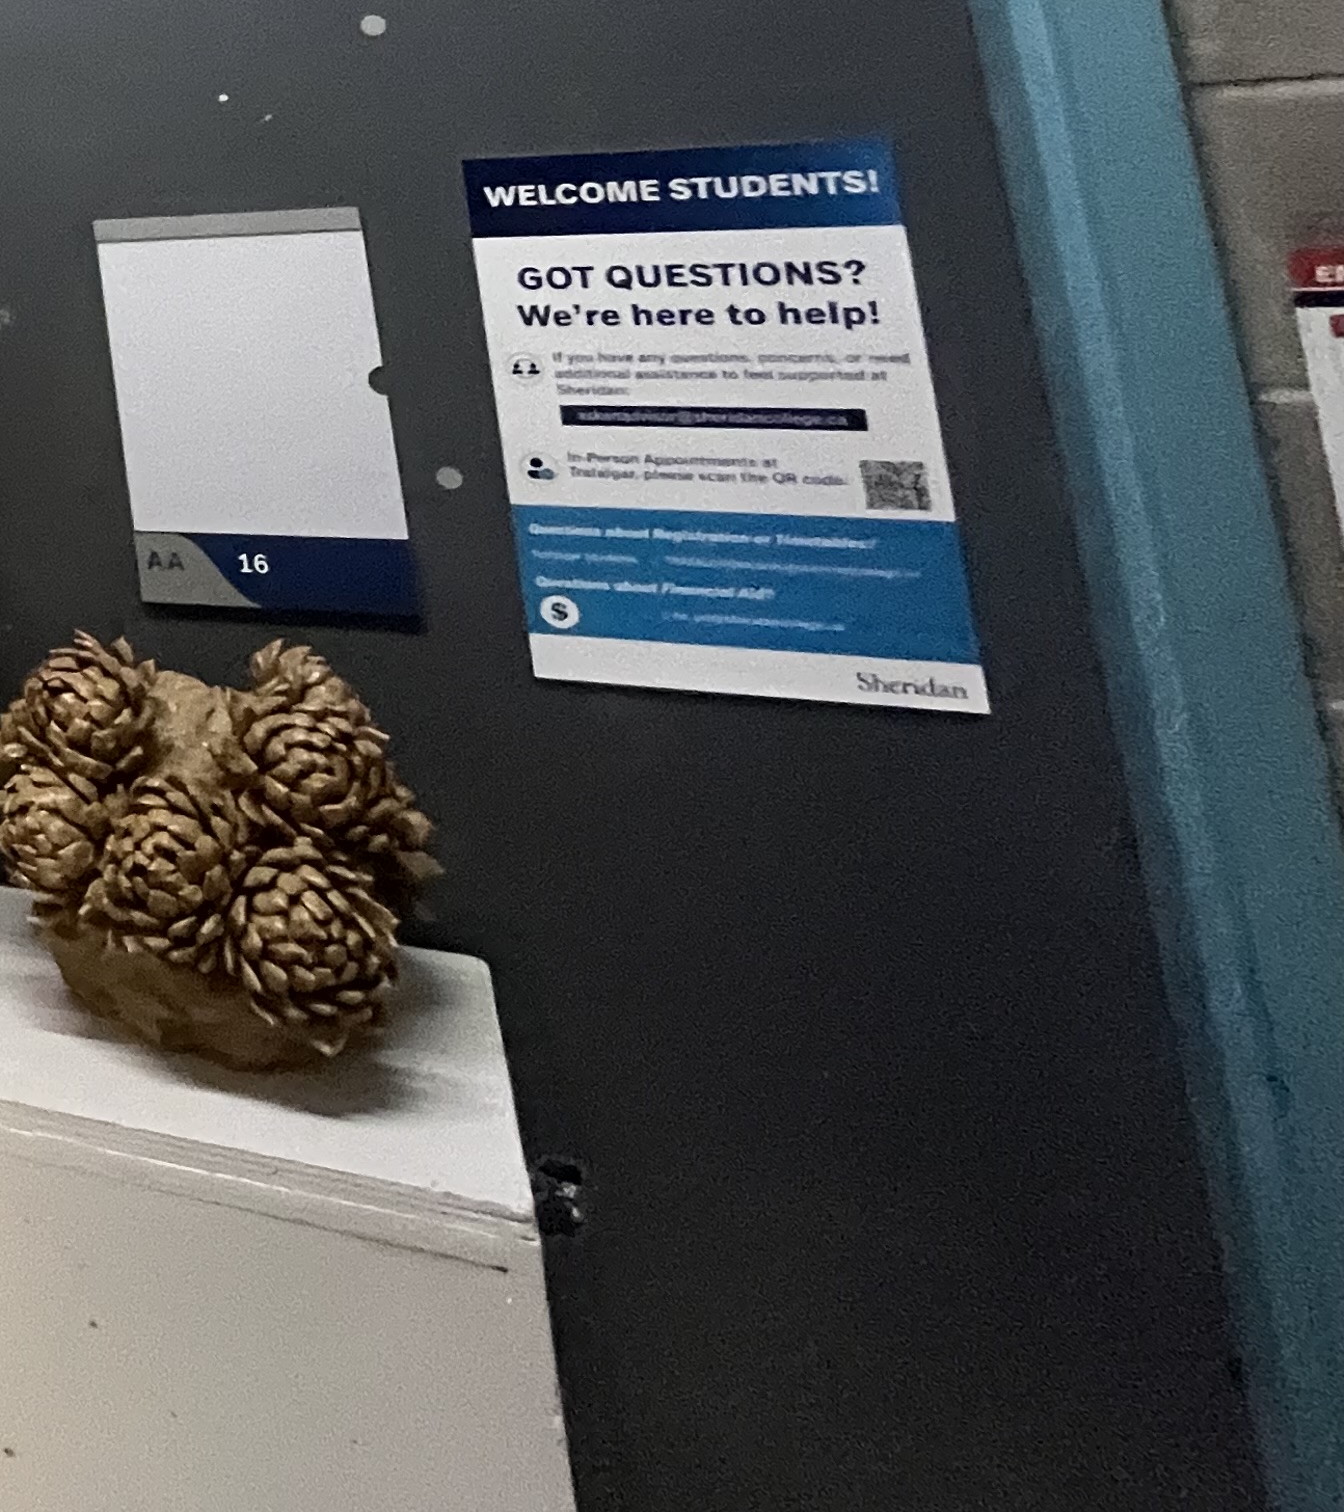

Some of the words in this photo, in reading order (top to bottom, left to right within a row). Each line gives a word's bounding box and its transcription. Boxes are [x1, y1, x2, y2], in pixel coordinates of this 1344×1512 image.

[483, 178, 661, 207] WELCOME
[669, 169, 880, 198] STUDENTS!
[517, 265, 594, 290] GOT
[606, 259, 866, 290] QUESTIONS?
[517, 303, 621, 327] We're
[632, 303, 715, 327] here
[728, 305, 766, 326] to
[778, 300, 881, 330] help!
[638, 354, 665, 365] any
[721, 370, 739, 379] to
[772, 472, 797, 484] QR
[147, 550, 185, 571] AA
[237, 552, 269, 574] 16
[856, 671, 969, 700] Sheridan
